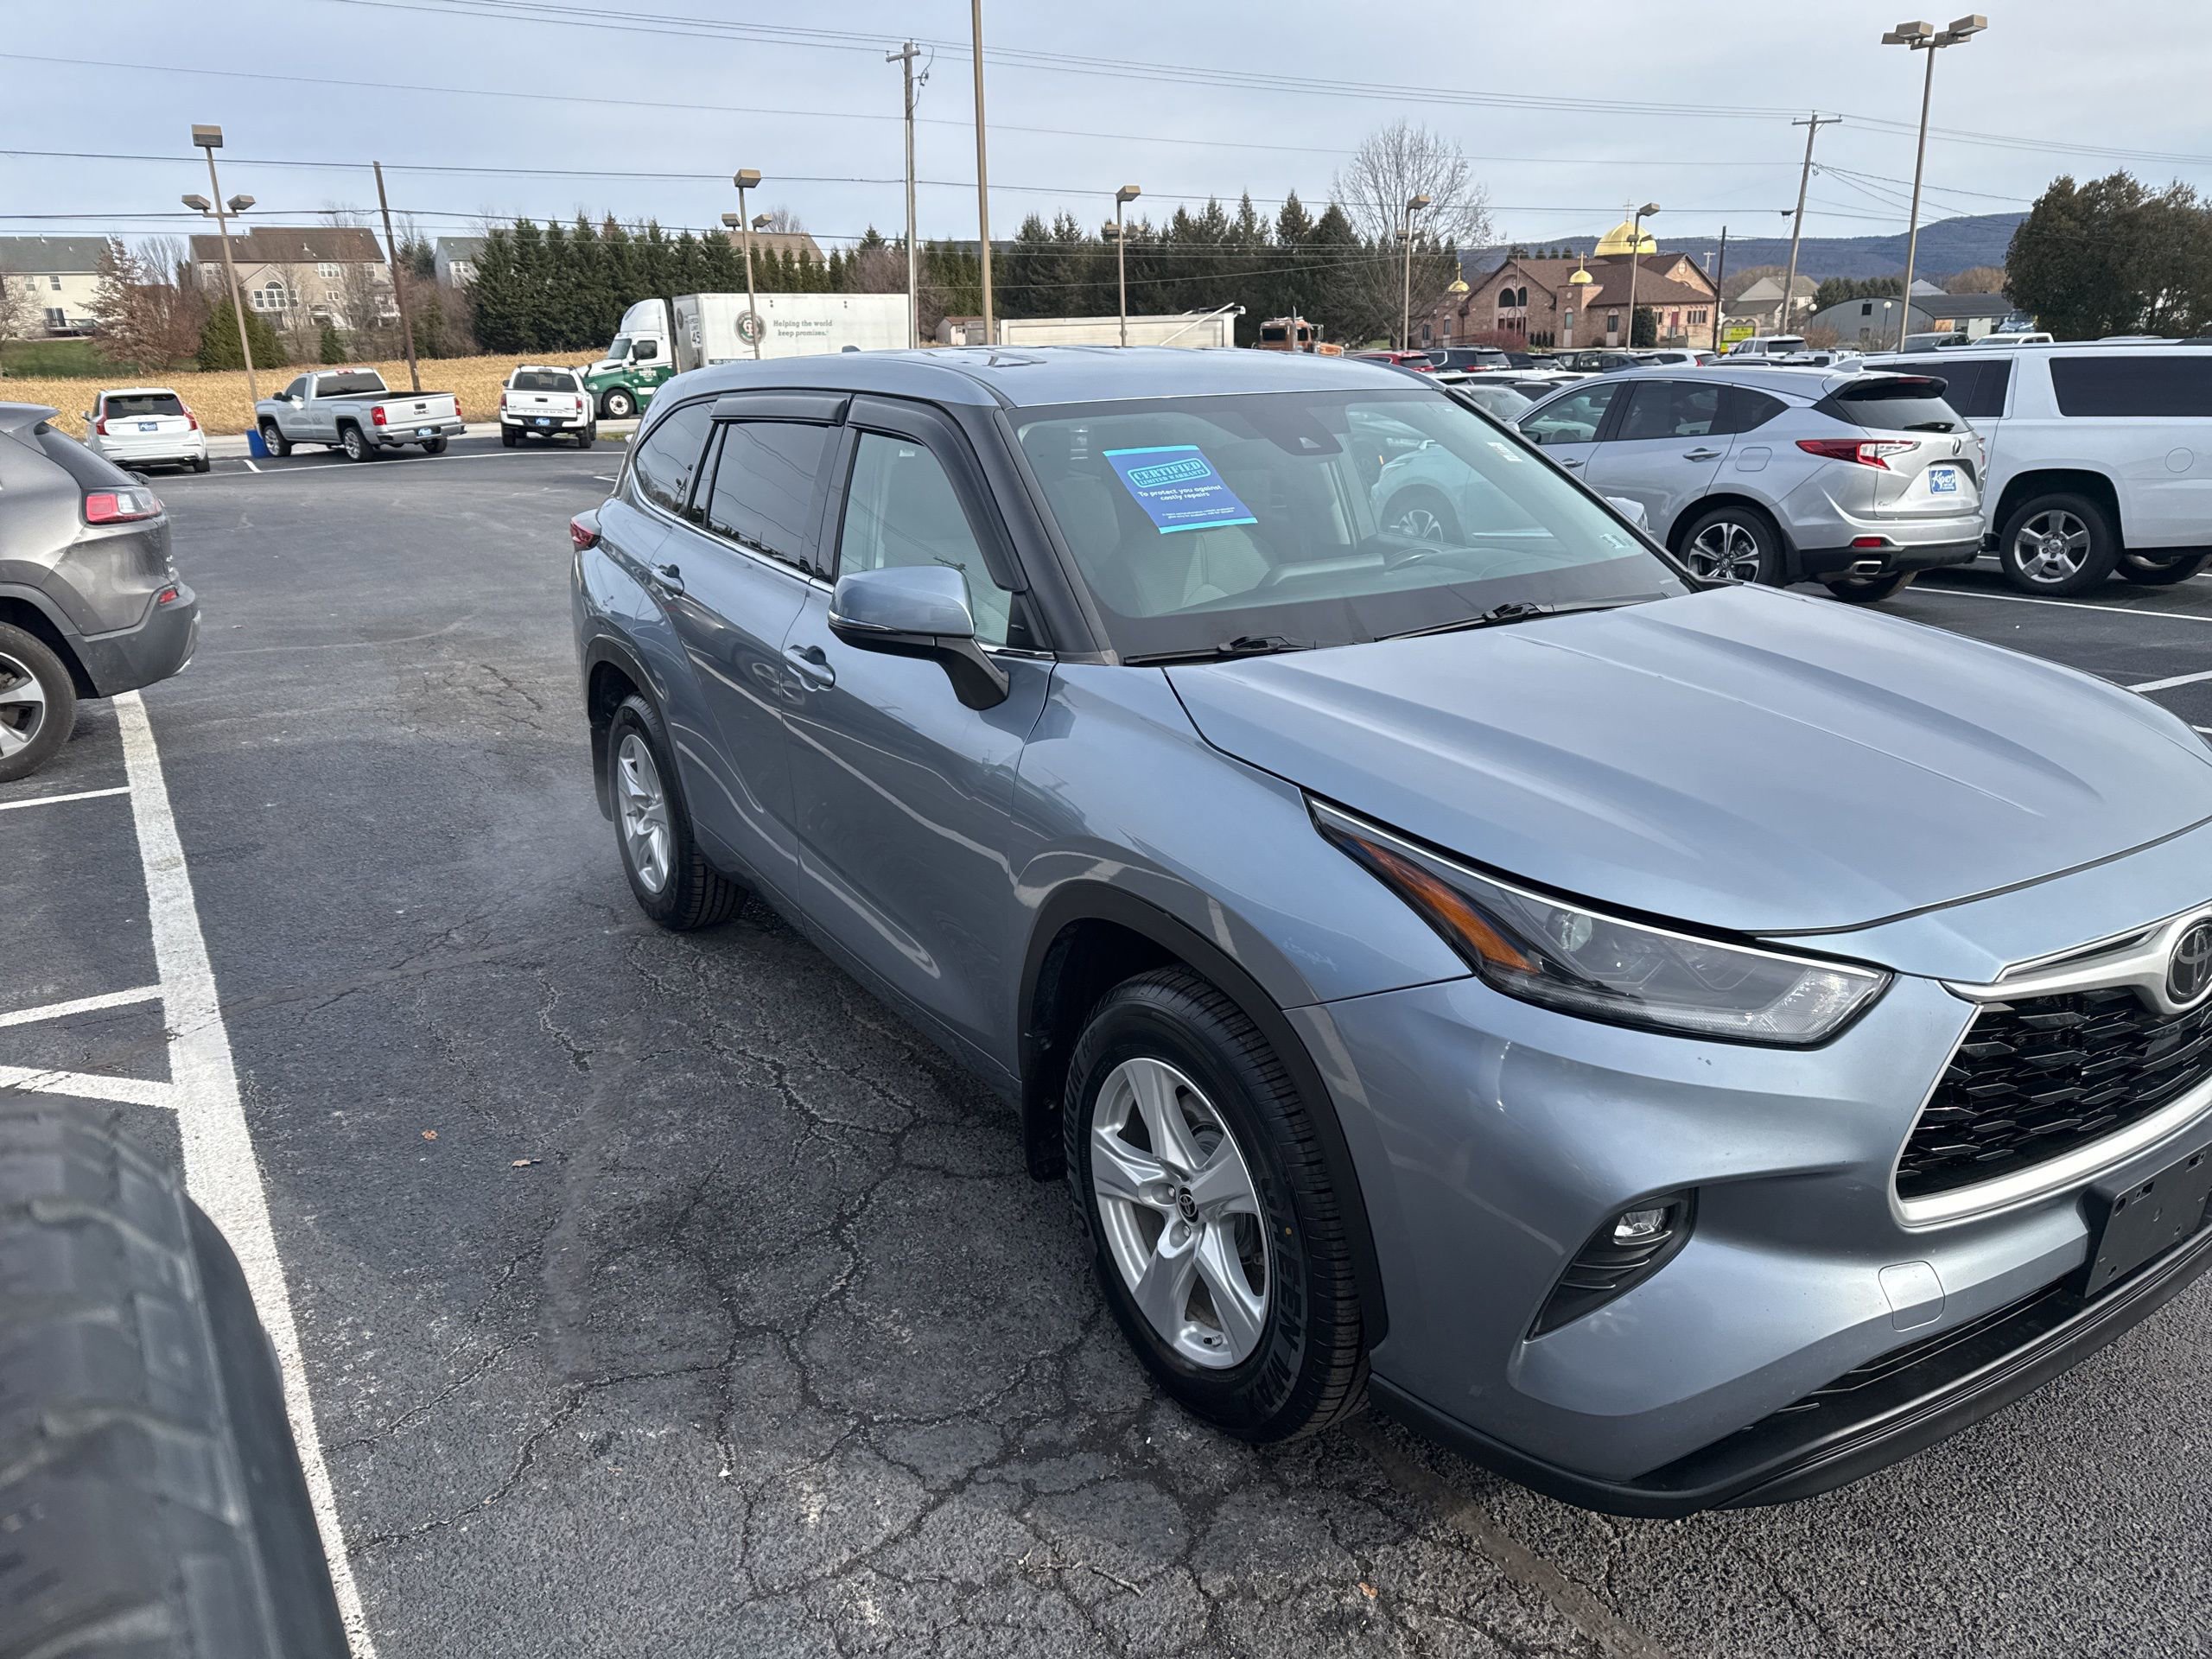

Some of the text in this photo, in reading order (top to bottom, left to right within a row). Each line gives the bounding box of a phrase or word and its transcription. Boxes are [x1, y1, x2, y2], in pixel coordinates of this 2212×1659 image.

[691, 332, 701, 344] 45
[778, 329, 795, 338] keep
[1133, 461, 1201, 480] CERTIFIED
[1139, 469, 1206, 485] LIMITED WARRANTY
[1148, 489, 1179, 498] protect
[1194, 485, 1223, 493] against
